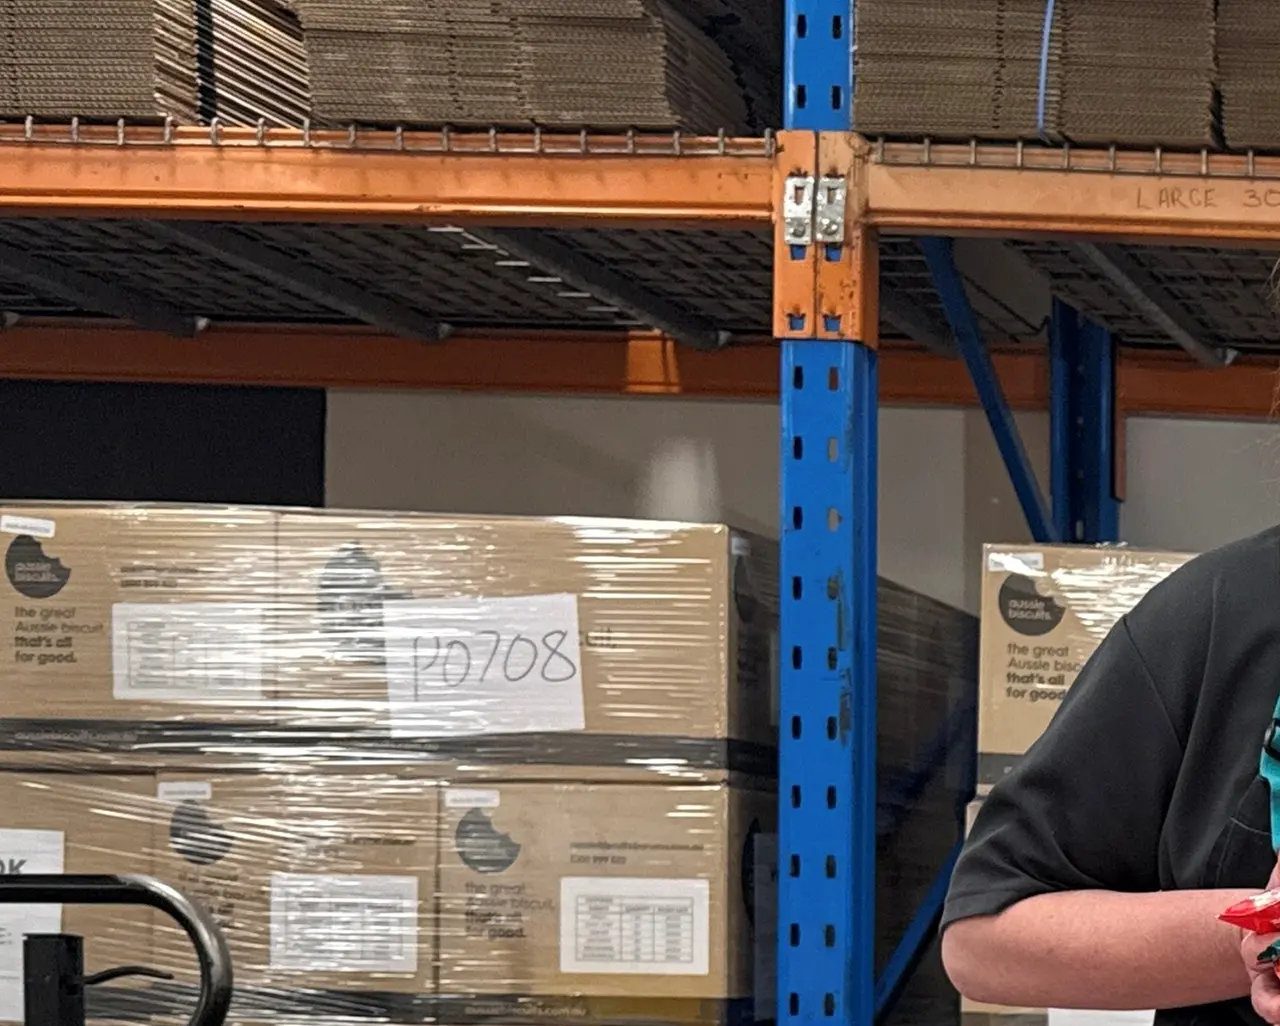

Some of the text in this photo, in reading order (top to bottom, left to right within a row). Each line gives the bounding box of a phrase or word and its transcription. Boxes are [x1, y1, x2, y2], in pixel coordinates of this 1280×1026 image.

[1007, 643, 1070, 659] the great
[1008, 657, 1050, 670] Aussie
[1007, 672, 1065, 685] that's all
[1006, 686, 1027, 698] for
